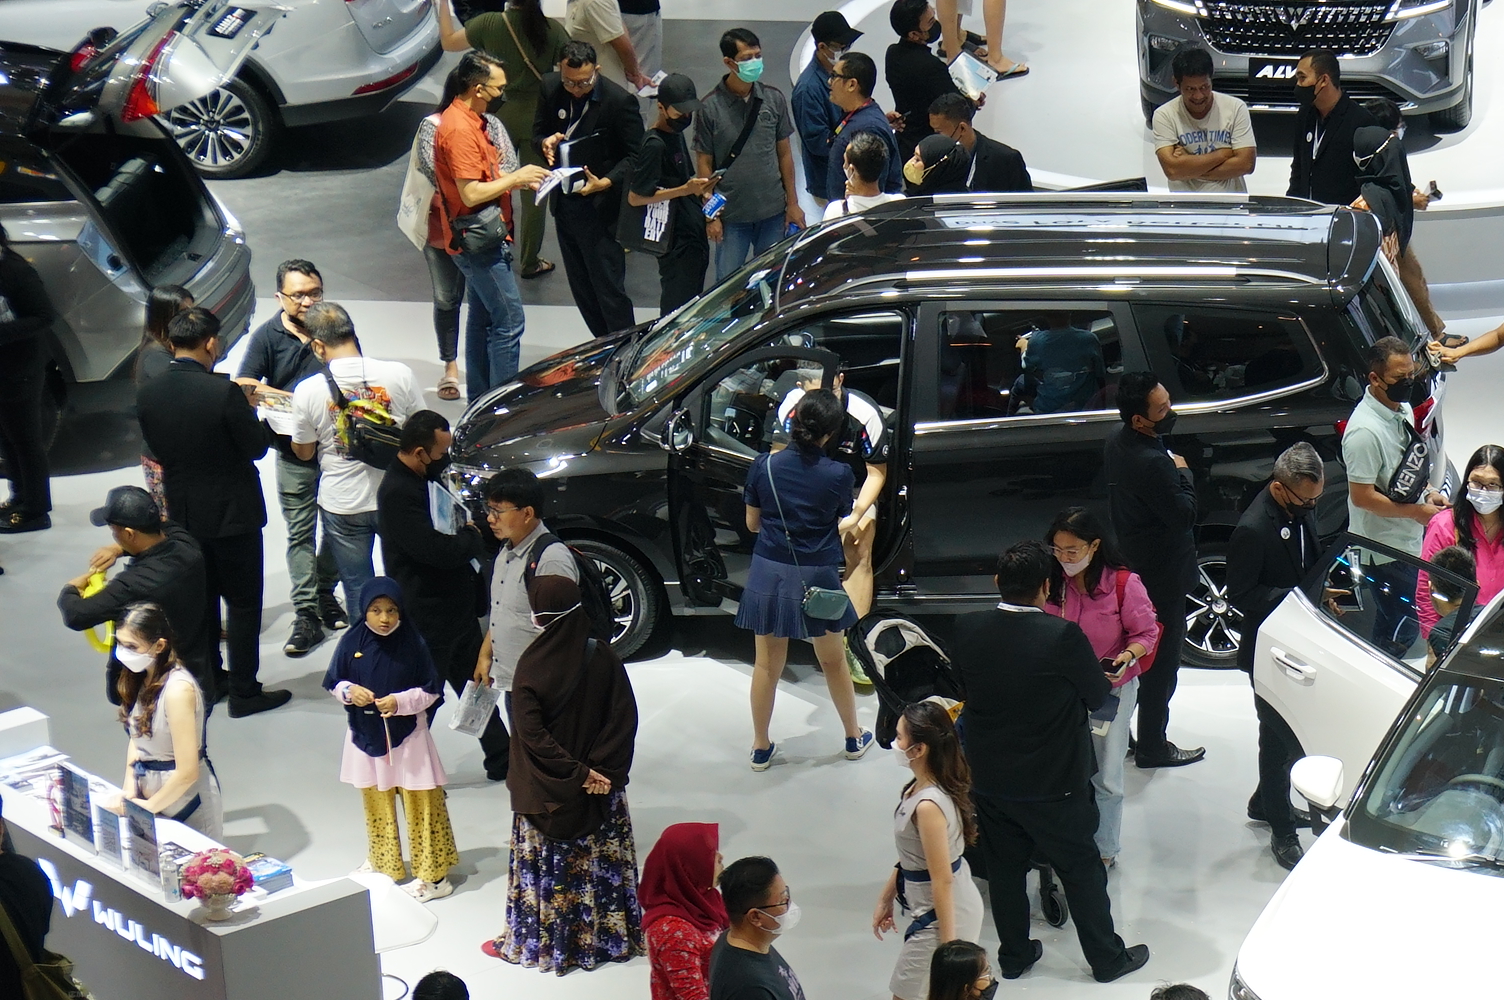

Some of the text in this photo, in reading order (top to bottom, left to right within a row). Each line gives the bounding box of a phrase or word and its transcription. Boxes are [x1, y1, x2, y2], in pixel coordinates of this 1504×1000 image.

[1256, 65, 1297, 78] ALV
[1178, 131, 1208, 147] ODERN
[1394, 443, 1428, 497] KENZO
[92, 900, 206, 981] WULING
